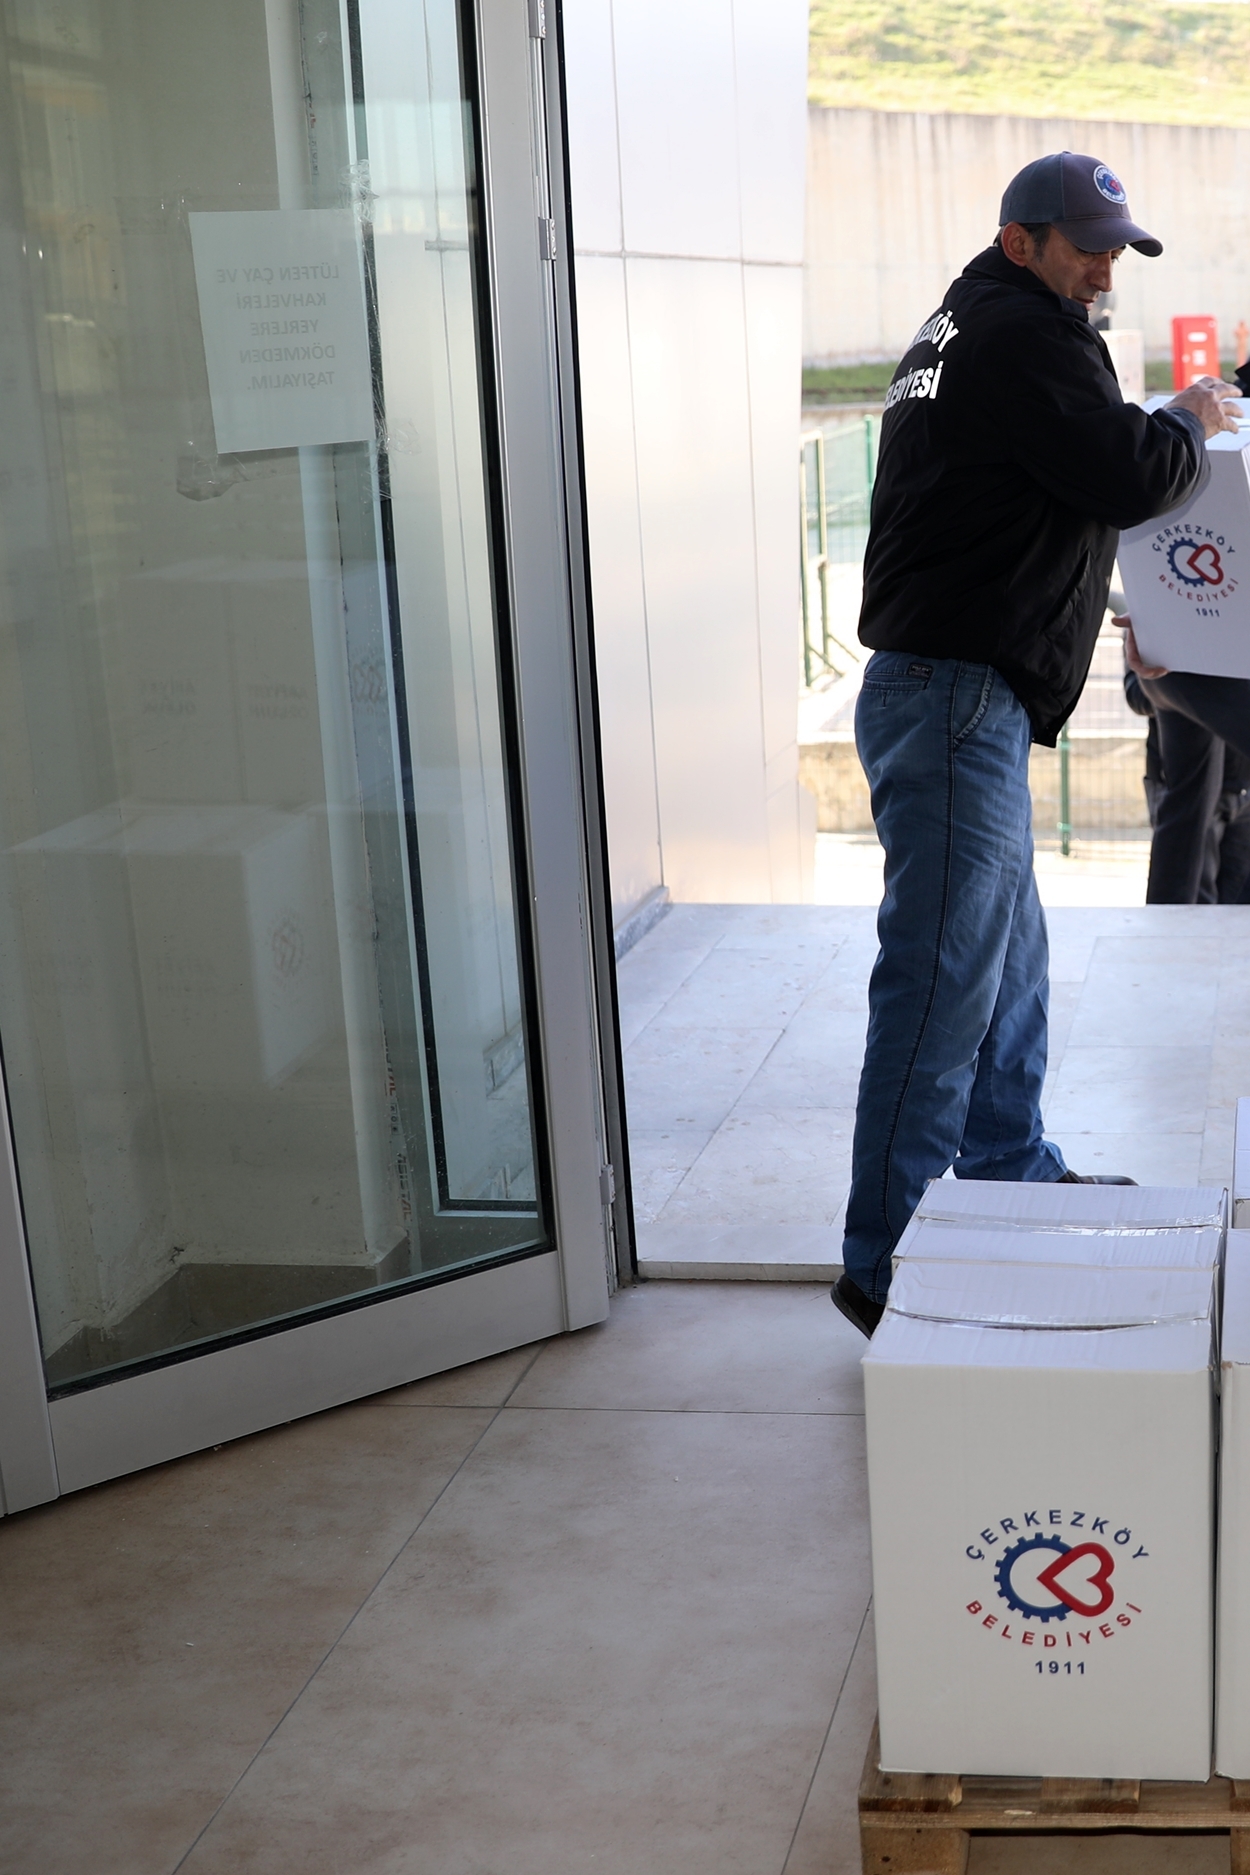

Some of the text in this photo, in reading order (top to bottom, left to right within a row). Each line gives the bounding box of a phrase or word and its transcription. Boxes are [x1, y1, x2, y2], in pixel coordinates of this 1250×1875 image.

[1152, 523, 1236, 555] ÇERKEZKÖY
[1158, 574, 1239, 603] BELEDİYESİ
[1195, 607, 1220, 617] 1911
[965, 1509, 1150, 1561] ÇERKEZKÖY
[966, 1600, 1142, 1647] BELEDİYESİ
[1035, 1660, 1085, 1675] 1911
